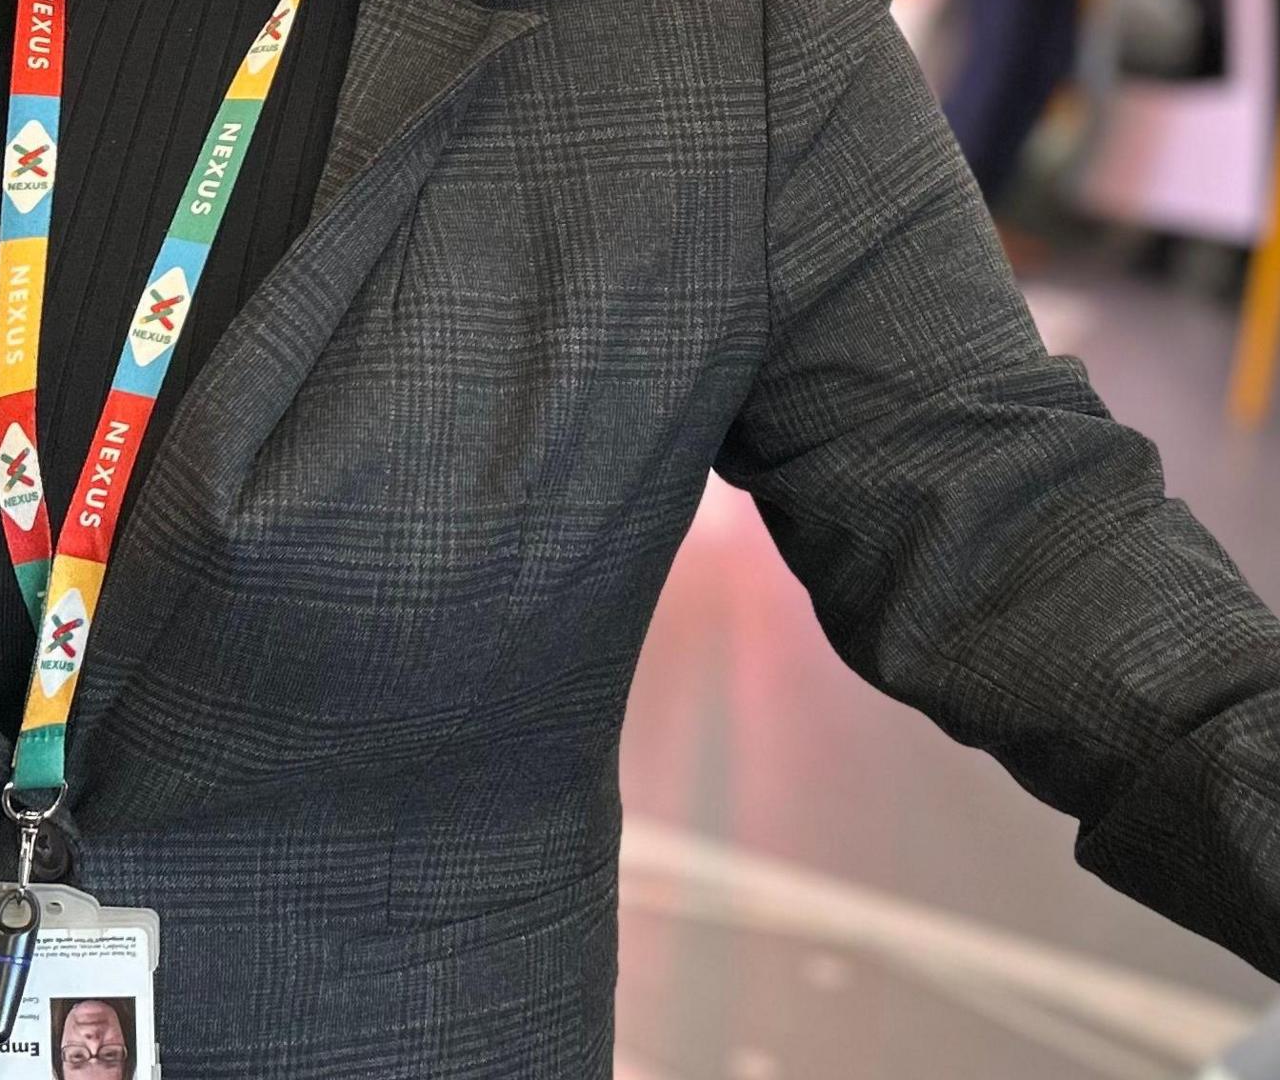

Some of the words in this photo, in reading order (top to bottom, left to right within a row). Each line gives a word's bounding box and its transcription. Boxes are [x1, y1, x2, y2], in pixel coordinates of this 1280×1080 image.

[249, 43, 279, 54] NEXUS
[191, 122, 242, 216] NEXUS
[7, 180, 49, 192] NEXUS
[5, 265, 30, 366] NEXUS
[132, 328, 173, 346] NEXUS
[80, 421, 130, 529] NEXUS
[4, 490, 40, 508] NEXUS
[40, 660, 75, 673] NEXUS
